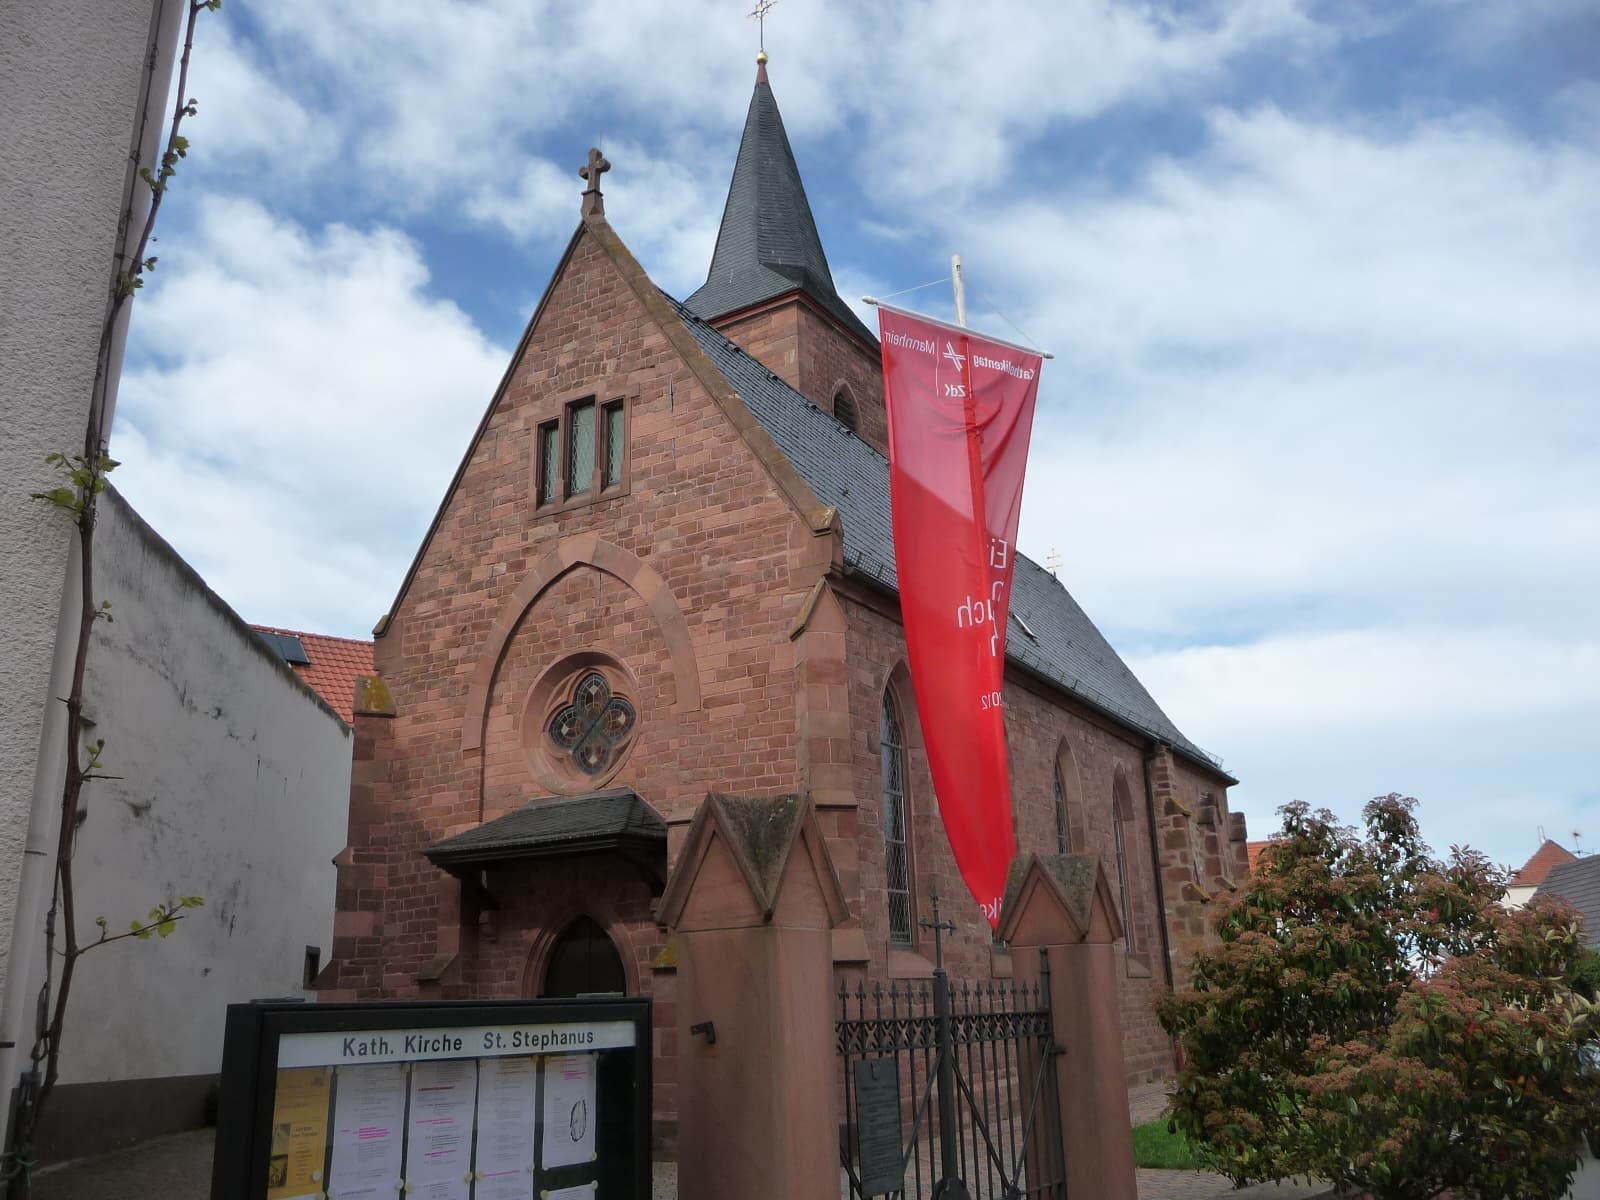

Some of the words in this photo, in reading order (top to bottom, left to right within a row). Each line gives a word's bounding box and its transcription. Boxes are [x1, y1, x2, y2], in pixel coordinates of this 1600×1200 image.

[343, 1036, 394, 1057] Kath.
[404, 1033, 463, 1054] Kirche
[483, 1031, 506, 1050] St.
[512, 1028, 594, 1051] Stephanus
